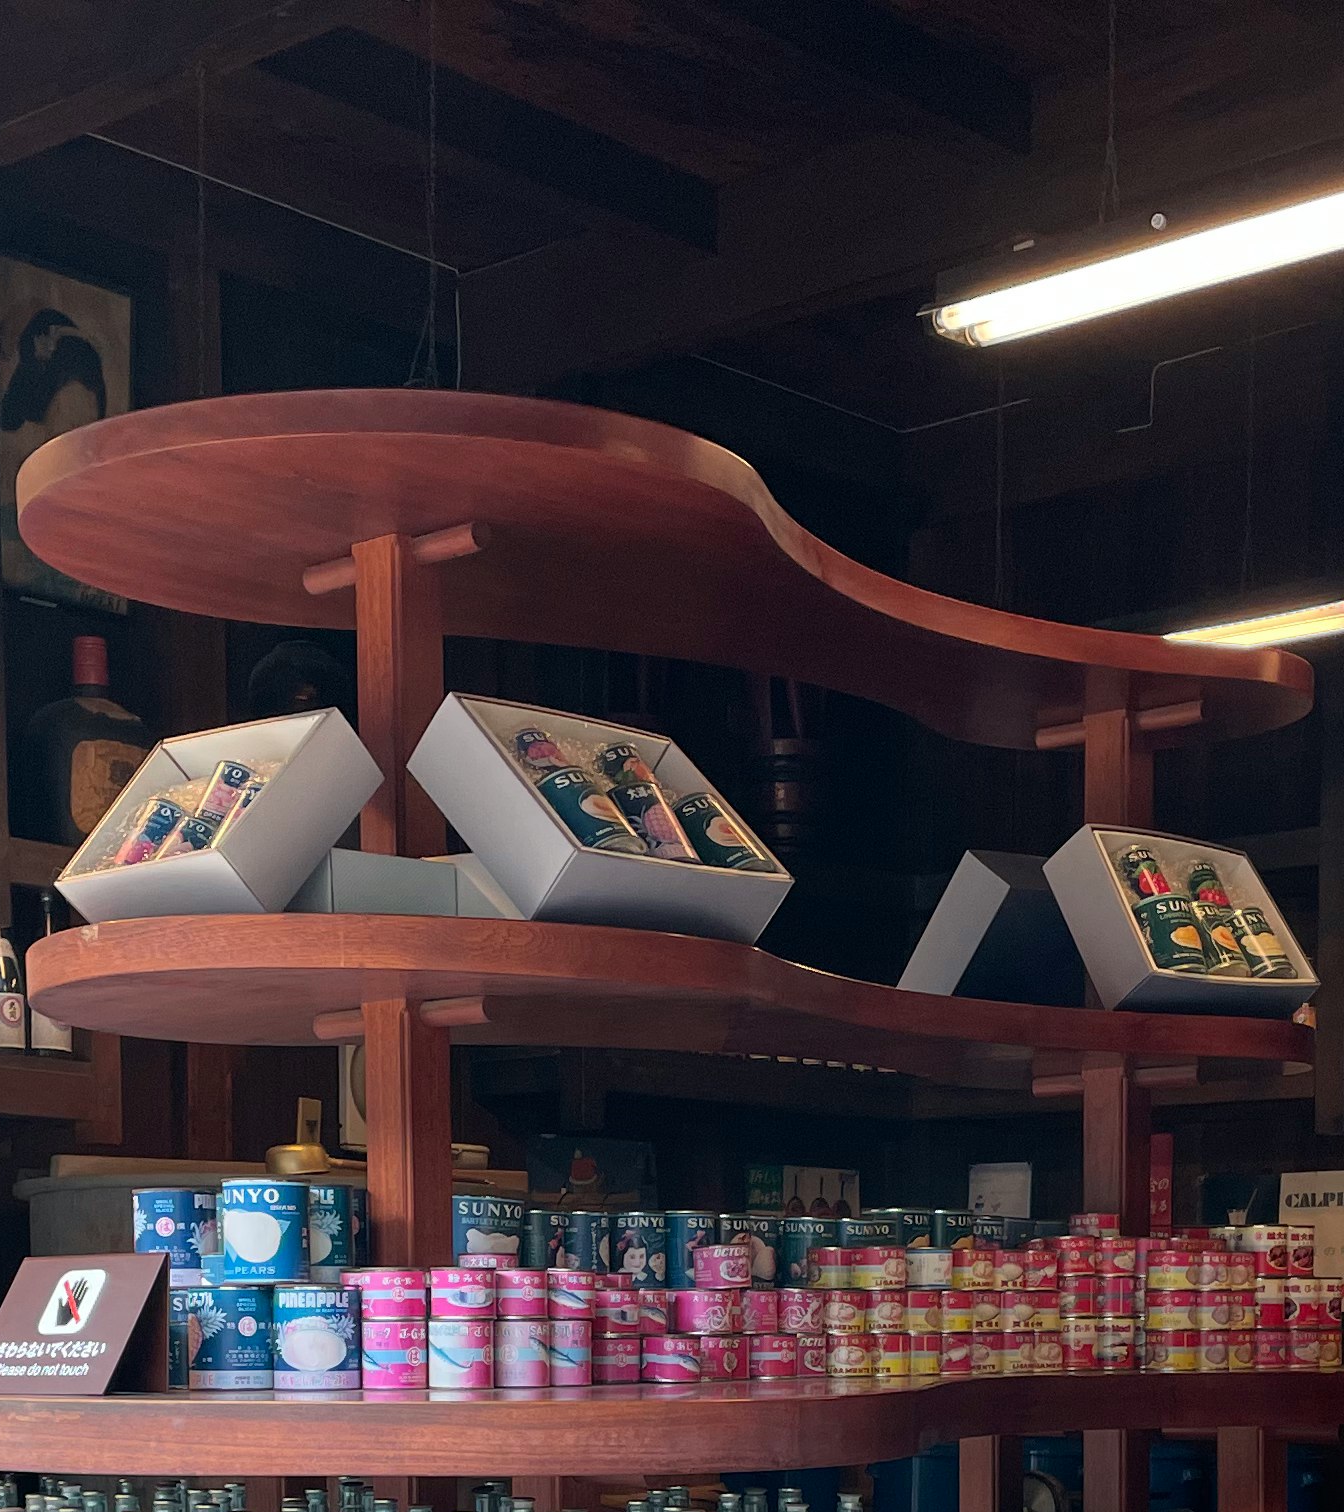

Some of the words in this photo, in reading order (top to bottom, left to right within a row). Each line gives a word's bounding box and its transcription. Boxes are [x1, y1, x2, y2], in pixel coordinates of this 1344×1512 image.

[458, 1201, 522, 1220] SUNYO
[722, 1220, 768, 1232] SUNYO
[785, 1222, 824, 1234] SUNYO
[846, 1225, 889, 1236] SUNYO
[235, 1266, 276, 1275] PEARS
[279, 1291, 349, 1308] PINEAPPLE
[27, 1363, 41, 1376] do
[41, 1363, 59, 1376] not
[59, 1363, 90, 1376] touch
